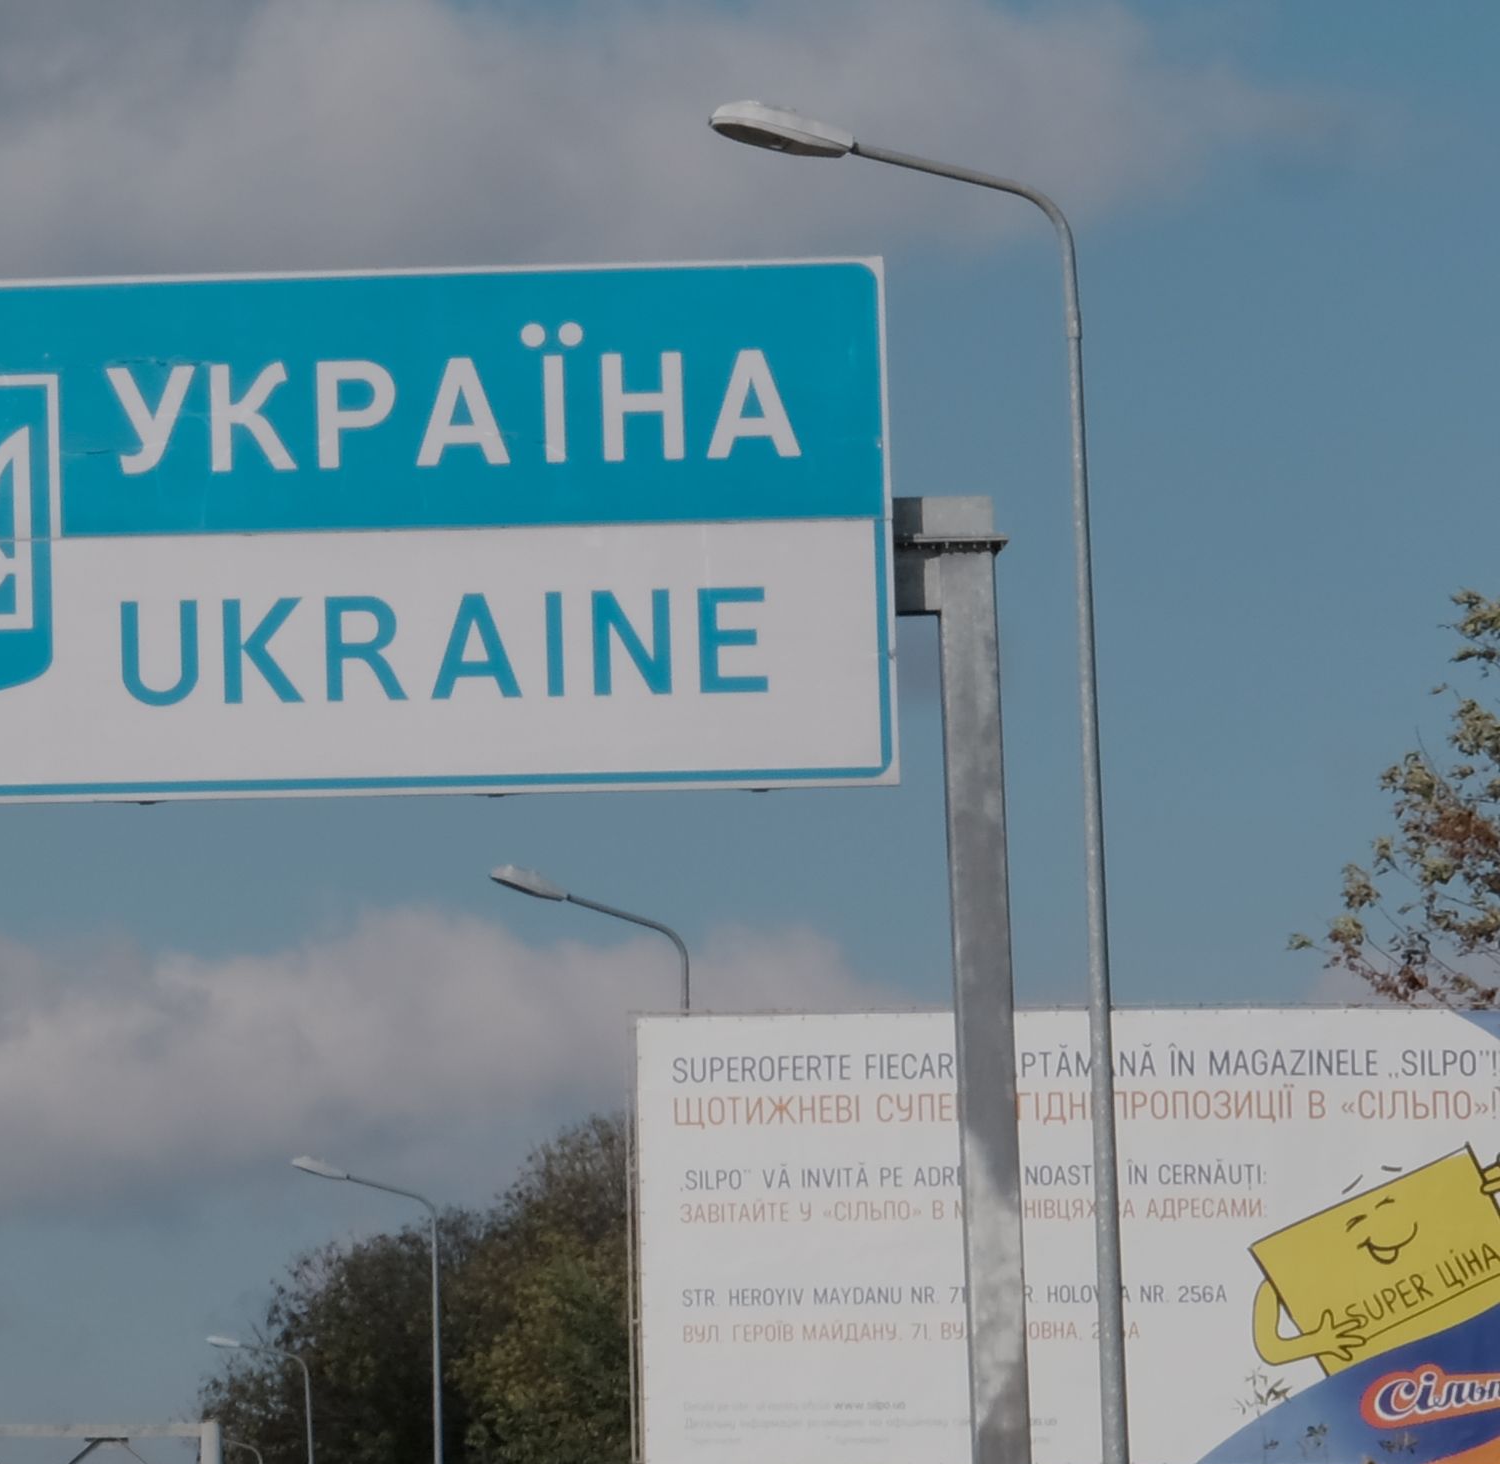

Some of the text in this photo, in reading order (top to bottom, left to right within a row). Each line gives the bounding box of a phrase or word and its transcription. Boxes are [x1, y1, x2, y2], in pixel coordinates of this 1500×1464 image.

[106, 321, 802, 476] УКРАЇНА
[119, 585, 769, 707] UKRAINE
[672, 1053, 852, 1083] SUPEROFERTE
[865, 1052, 955, 1080] FIECAR
[1170, 1042, 1195, 1076] ÎN
[1209, 1050, 1379, 1076] MAGAZINELE
[673, 1094, 860, 1129] ЩОТИЖНЕВІ
[1308, 1090, 1326, 1120] В
[762, 1163, 791, 1189] VĂ
[801, 1161, 869, 1188] INVITĂ
[879, 1166, 903, 1187] PE
[1128, 1159, 1148, 1186] ÎN
[680, 1199, 790, 1224] ЗАВІТАЙТЕ
[799, 1201, 813, 1222] У
[823, 1200, 922, 1222] «СІЛЬПО»
[931, 1200, 945, 1220] В
[682, 1288, 719, 1307] STR.
[728, 1288, 804, 1306] HEROYIV
[813, 1286, 902, 1305] MAYDANU
[911, 1286, 939, 1304] NR.
[1140, 1285, 1170, 1303] NR.
[1178, 1284, 1227, 1303] 256A
[1345, 1273, 1434, 1329] SUPER
[682, 1325, 719, 1343] ВУЛ.
[732, 1320, 794, 1342] ГЕРОЇВ
